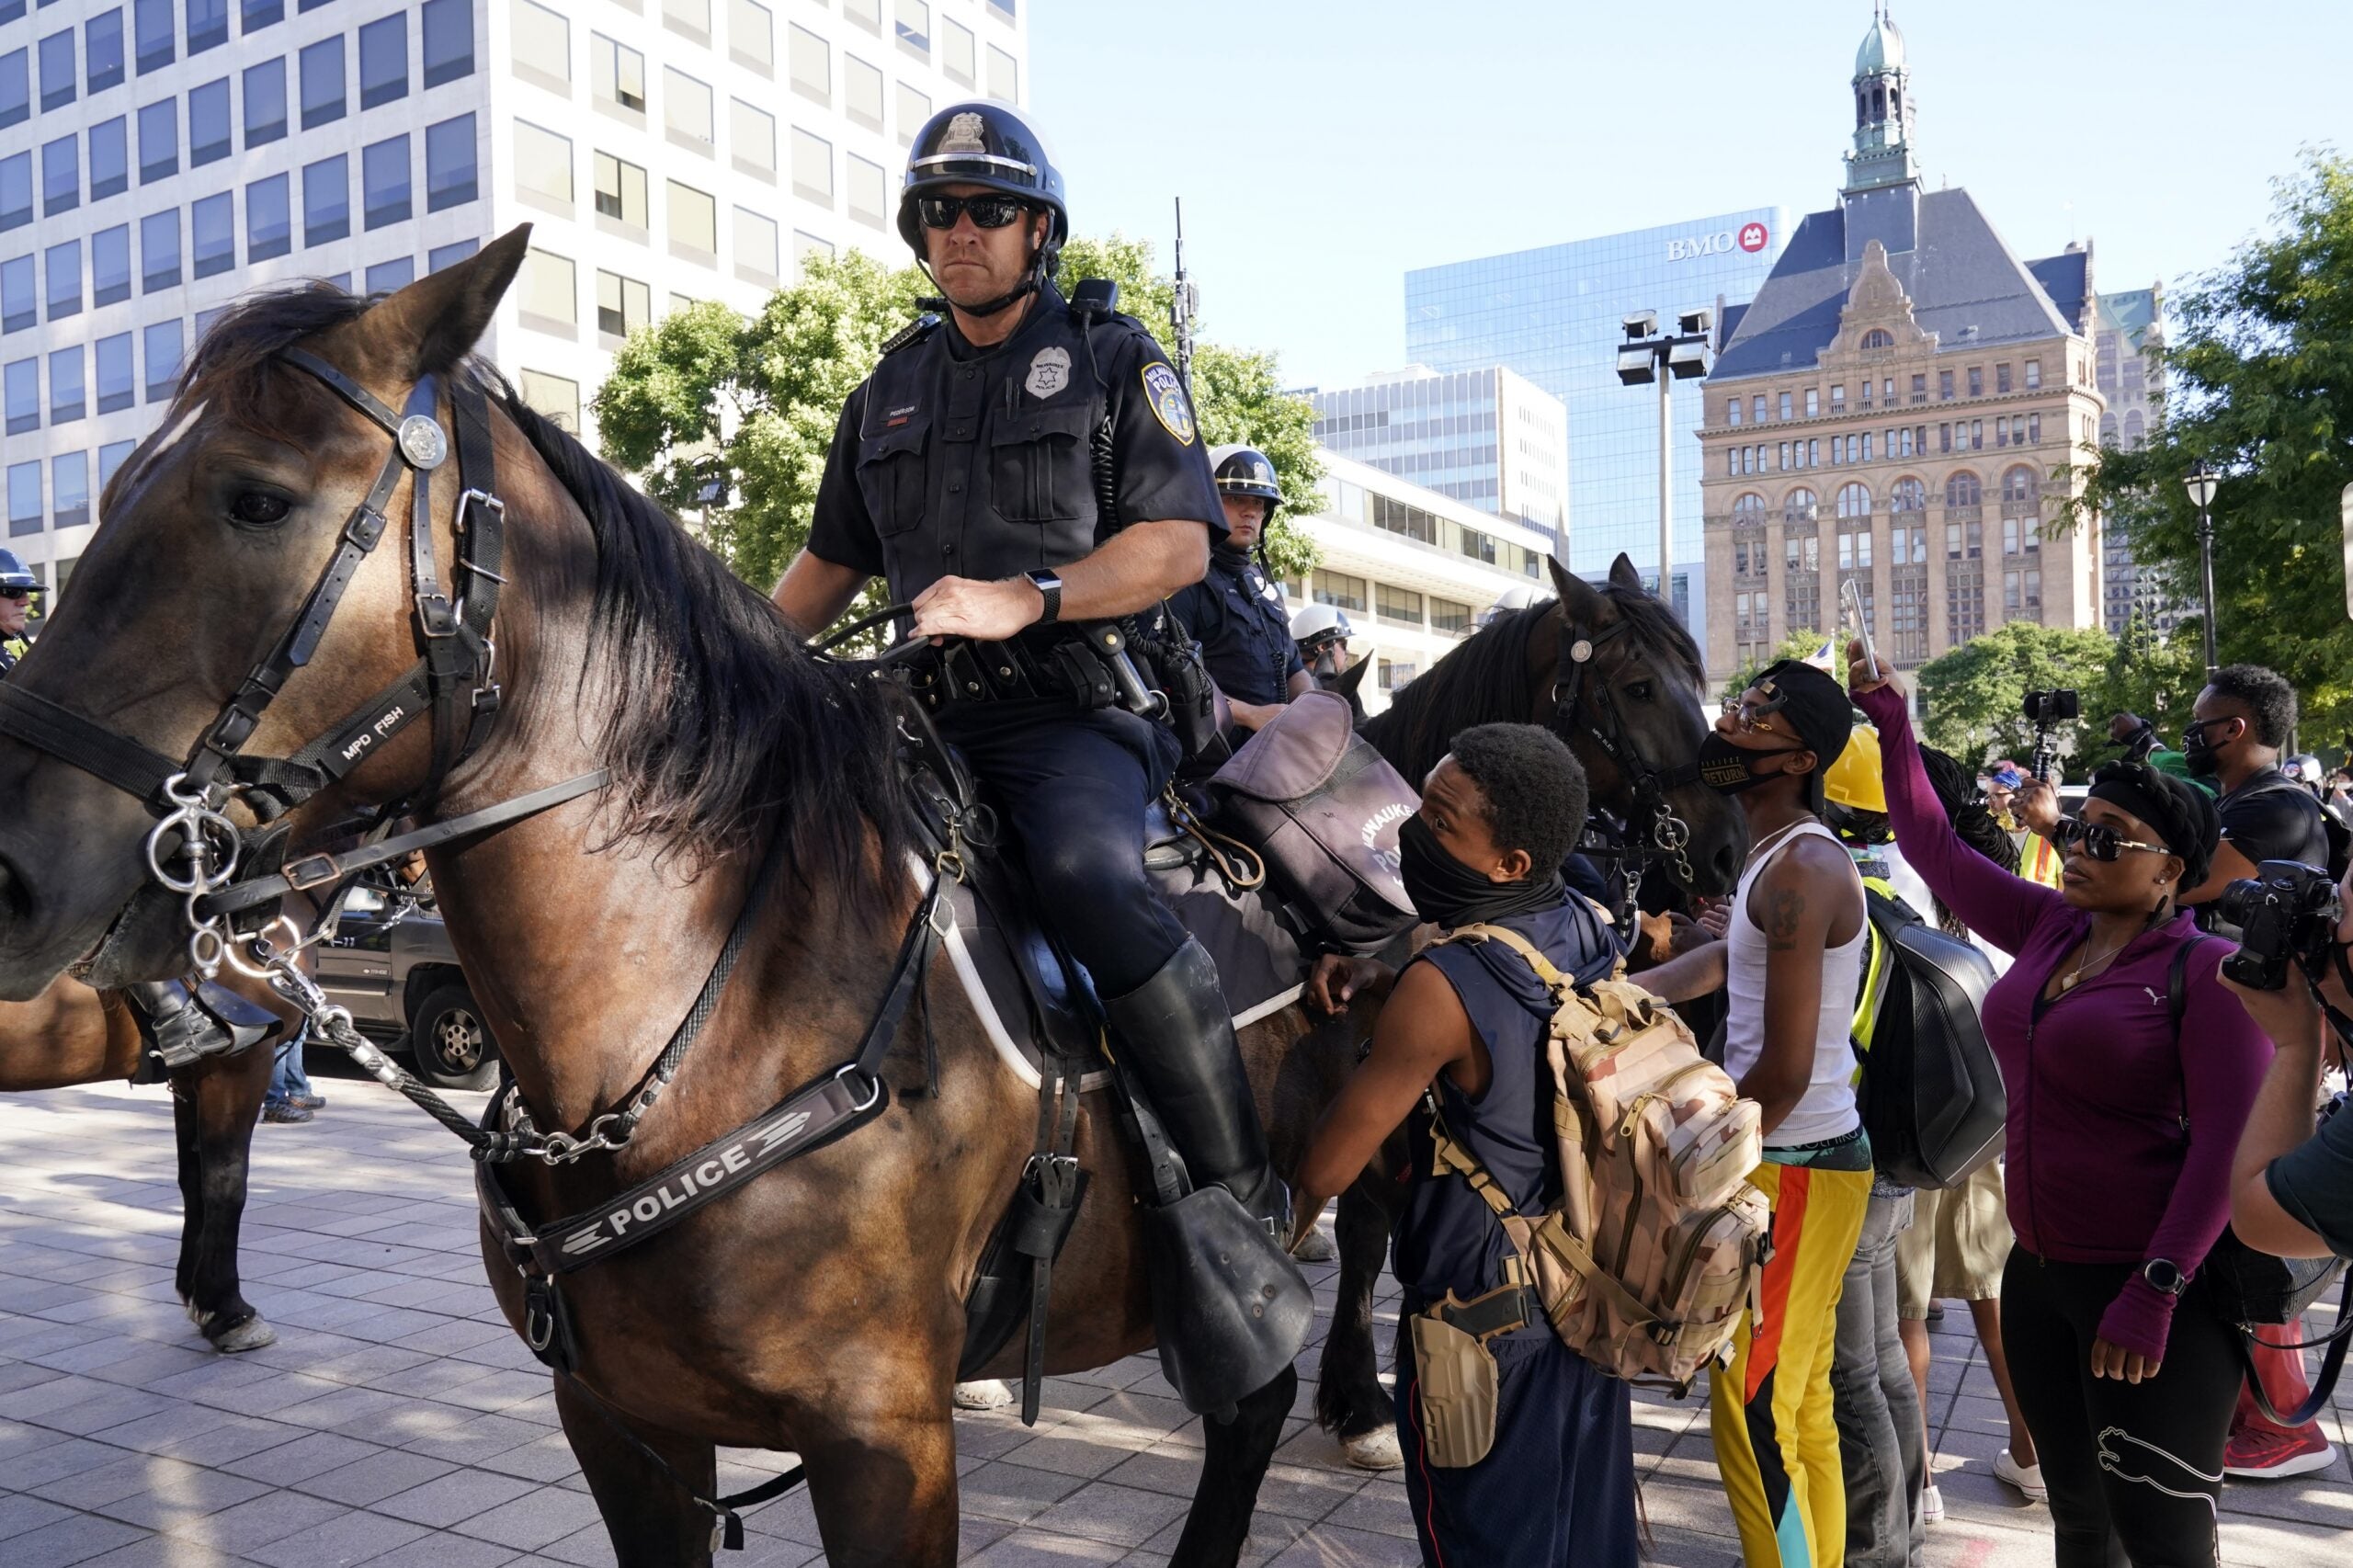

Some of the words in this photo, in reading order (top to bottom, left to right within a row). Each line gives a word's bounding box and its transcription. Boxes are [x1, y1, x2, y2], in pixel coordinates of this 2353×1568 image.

[1666, 232, 1735, 262] BMO
[342, 734, 371, 760] MPD
[373, 706, 404, 735] FISH
[1703, 767, 1745, 784] RETURN
[608, 1144, 752, 1235] POLICE
